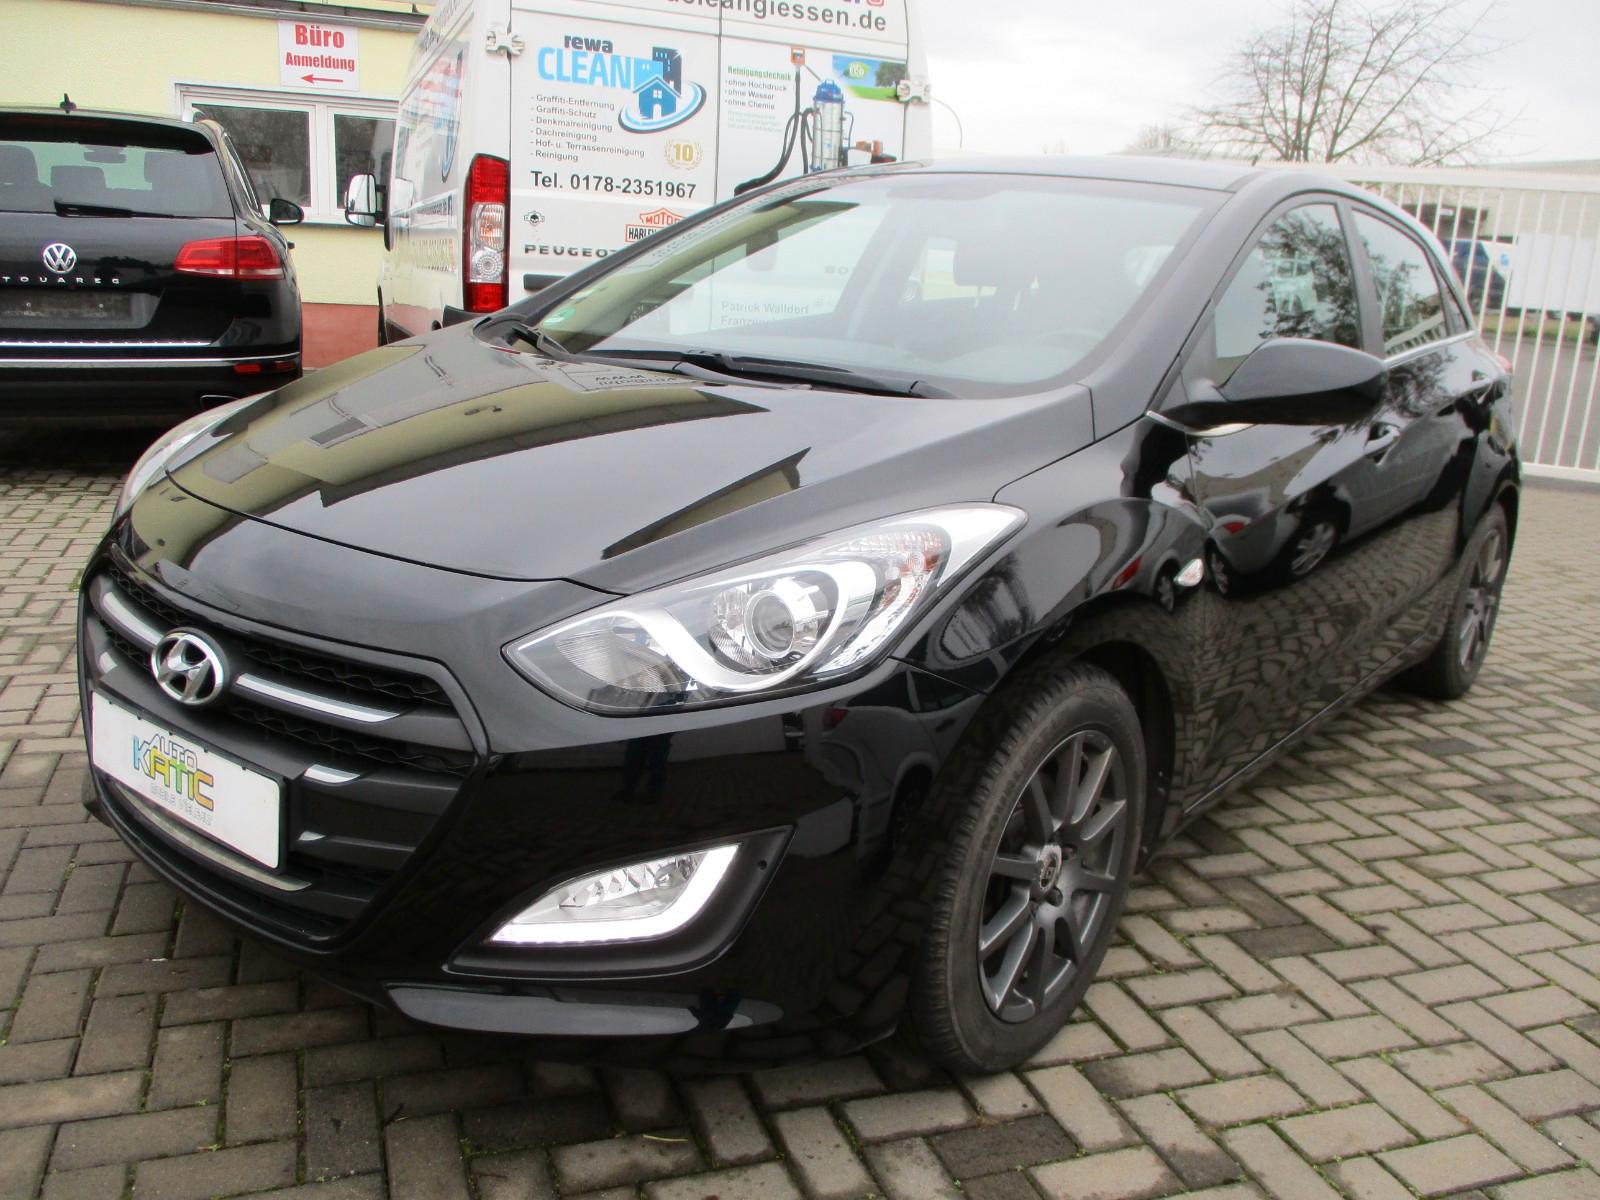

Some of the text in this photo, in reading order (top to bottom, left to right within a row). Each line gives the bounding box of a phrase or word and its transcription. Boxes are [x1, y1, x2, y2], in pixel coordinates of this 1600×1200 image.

[294, 23, 345, 49] Büro
[564, 35, 614, 54] rewa
[285, 51, 355, 72] Anmeldung
[537, 47, 631, 90] CLEAN
[727, 65, 792, 81] Reinigungstechnik
[728, 79, 788, 92] ohne Hochdruck
[536, 94, 615, 111] Graffiti-Entfernung
[728, 89, 775, 101] ohne Wasser
[536, 105, 597, 119] Graffiti-Schutz
[728, 99, 776, 110] ohne Chemie
[536, 116, 613, 133] Denkmalreinigung
[535, 128, 598, 143] Dachreinigung
[535, 139, 555, 149] Hof-
[566, 141, 645, 159] Terrassenreinigung
[535, 150, 579, 163] Reinigung
[673, 143, 694, 163] 10
[530, 170, 697, 199] Tel. 0178-2351967
[524, 244, 617, 258] PEUGEO
[2, 276, 120, 285] TOUAREG
[721, 300, 809, 315] Patrick Walldorf
[148, 733, 198, 771] AUTO
